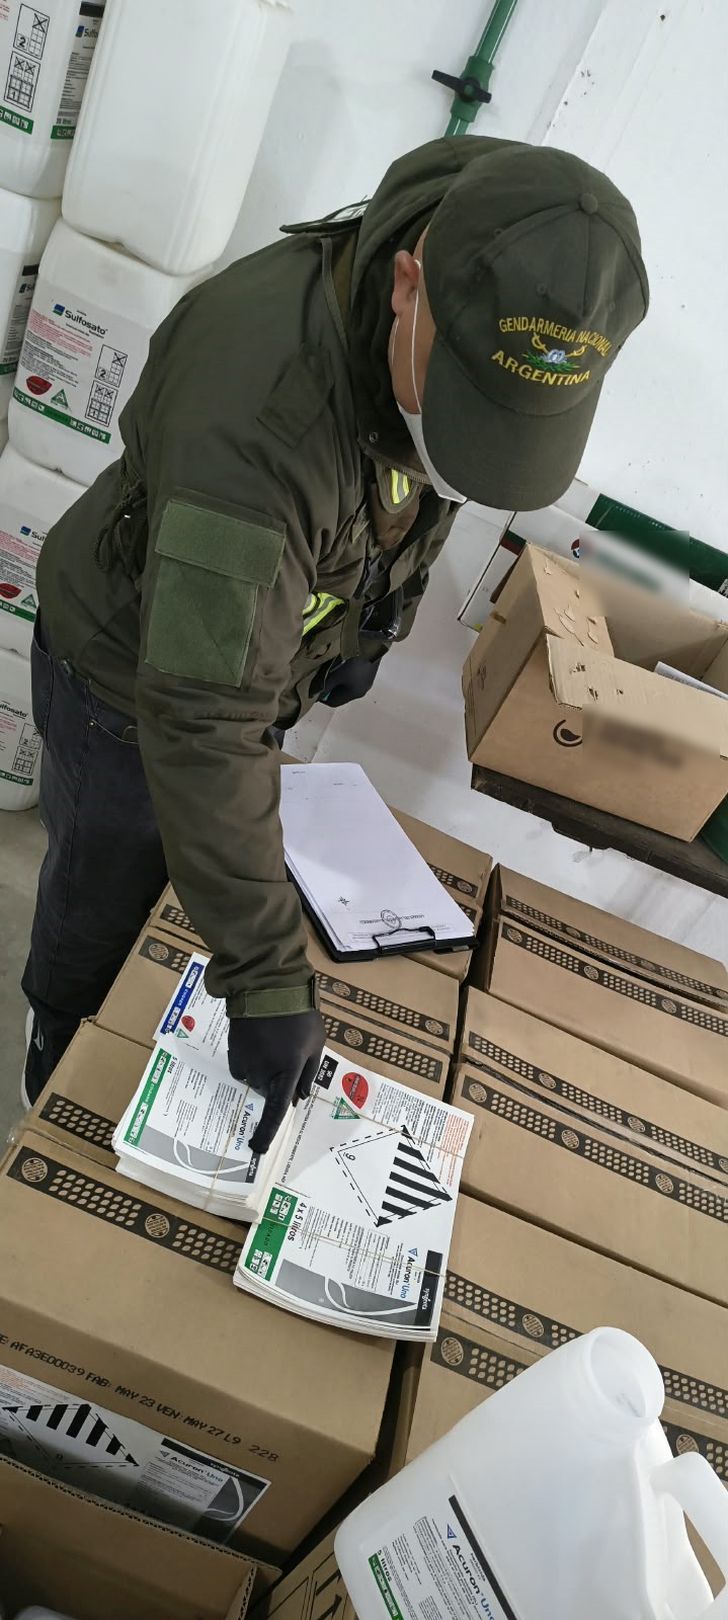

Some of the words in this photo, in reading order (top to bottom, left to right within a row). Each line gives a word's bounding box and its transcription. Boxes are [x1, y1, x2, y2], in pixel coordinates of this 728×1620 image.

[65, 310, 106, 335] Sulfosato
[499, 316, 576, 341] GENDARMERIA
[577, 330, 613, 357] NACIONAL
[491, 350, 591, 386] ARGENTINA
[240, 1110, 250, 1136] Acuron
[234, 1137, 243, 1151] Uno
[286, 1220, 300, 1242] litros
[402, 1256, 414, 1283] Acuron
[399, 1284, 409, 1298] Uno
[115, 1385, 140, 1402] MAY
[139, 1396, 156, 1408] 23
[184, 1414, 208, 1431] MAY
[208, 1424, 226, 1438] 27
[249, 1445, 280, 1462] 228
[170, 1455, 204, 1473] Acuron
[452, 1545, 480, 1594] Acuron
